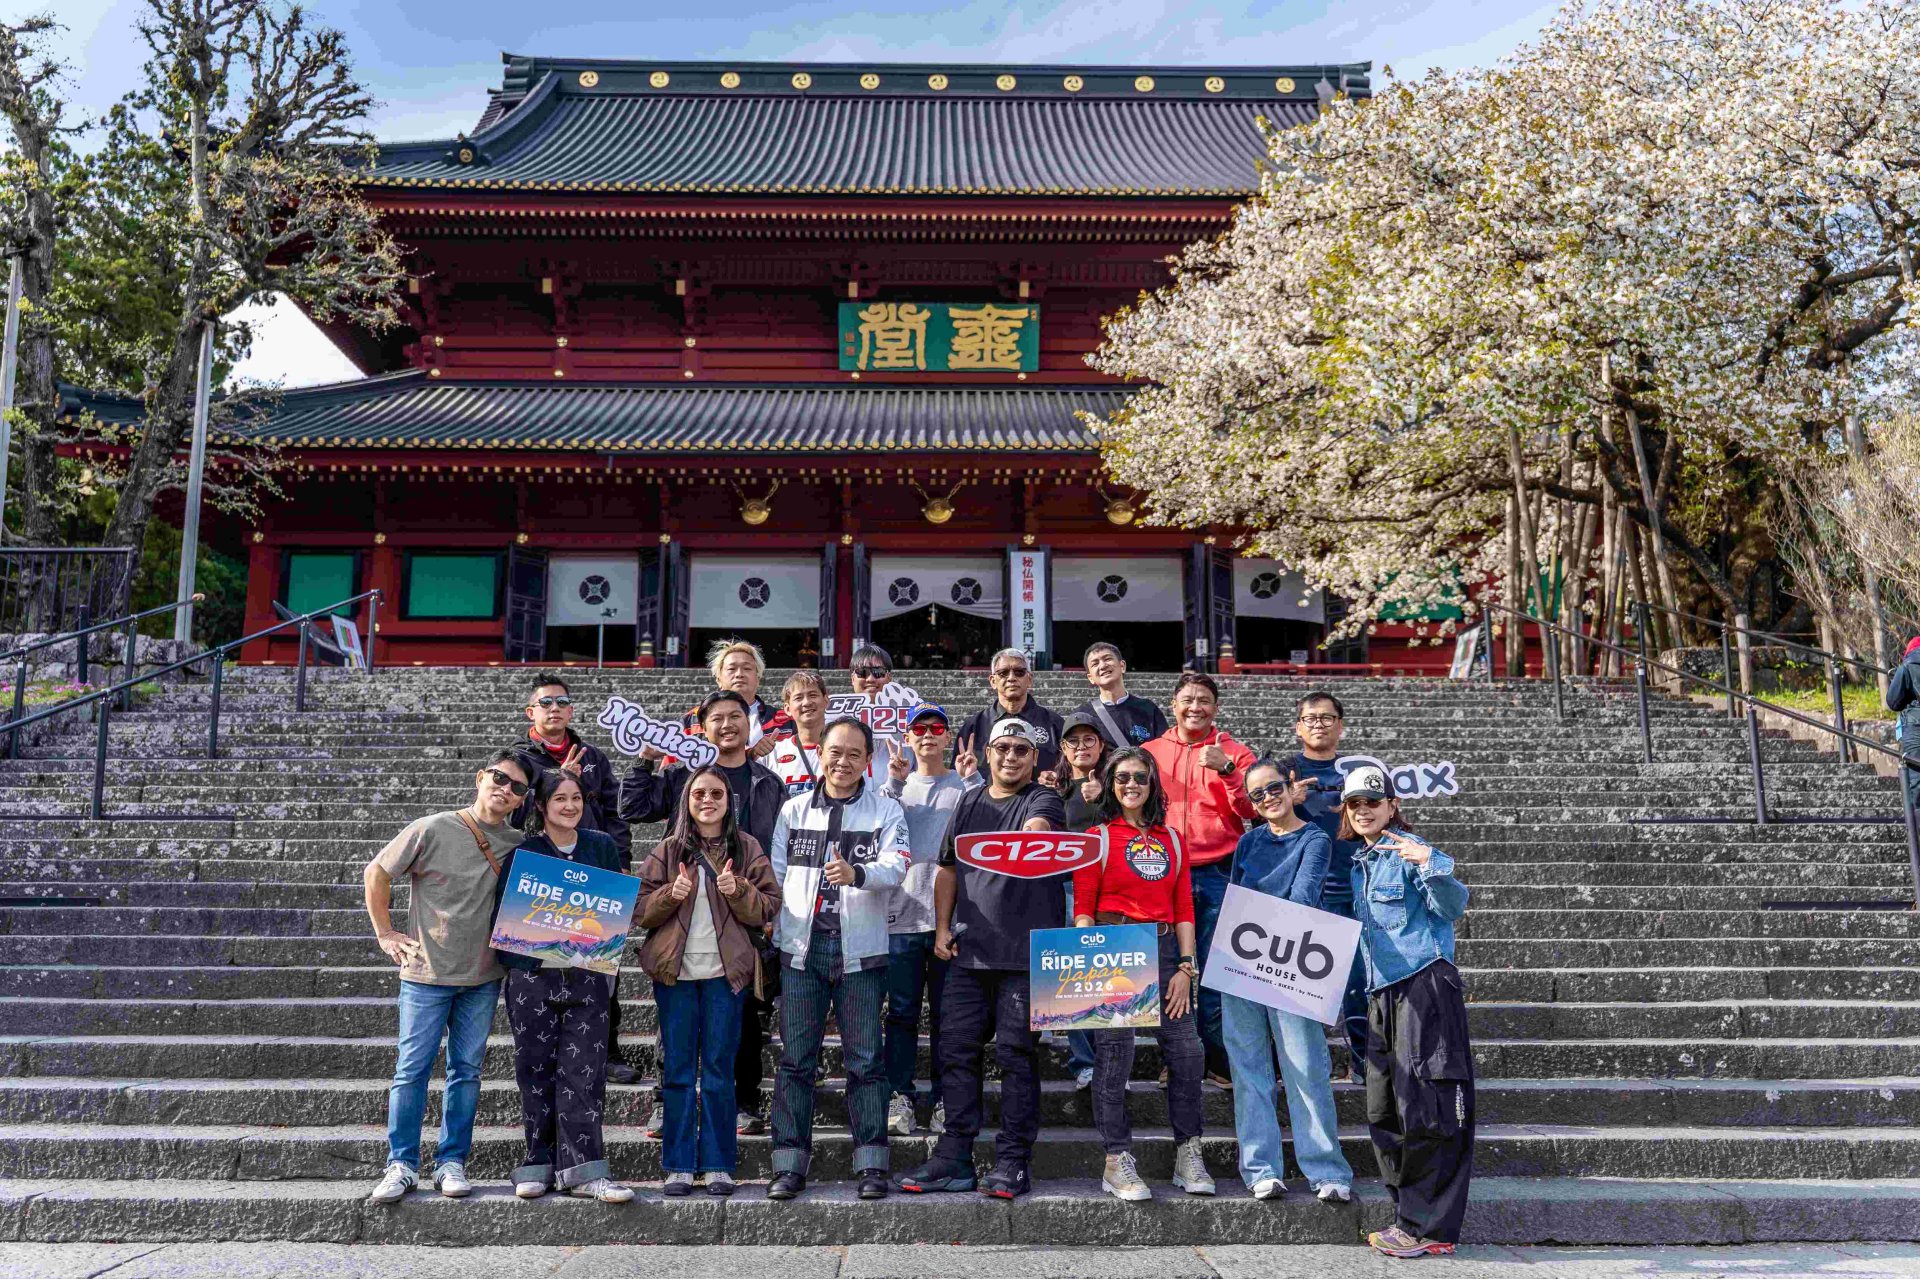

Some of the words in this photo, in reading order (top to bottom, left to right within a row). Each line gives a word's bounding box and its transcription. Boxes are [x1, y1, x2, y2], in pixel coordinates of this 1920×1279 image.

[826, 696, 866, 714] CT
[600, 699, 718, 767] Monkey
[970, 840, 1086, 862] C125
[563, 869, 589, 883] Cub
[517, 878, 564, 901] RIDE
[569, 891, 623, 916] OVER
[524, 893, 602, 920] Japan
[543, 912, 583, 930] 2026
[1080, 932, 1106, 945] Cub
[1041, 954, 1086, 971] RIDE
[1092, 951, 1148, 968] OVER
[1230, 922, 1334, 980] Cub
[1056, 965, 1129, 995] Japan
[1224, 966, 1248, 977] CULTURE
[1252, 975, 1273, 985] UNIQUE
[1278, 982, 1294, 991] BIKES
[1256, 963, 1297, 982] HOUSE
[1074, 981, 1113, 993] 2026
